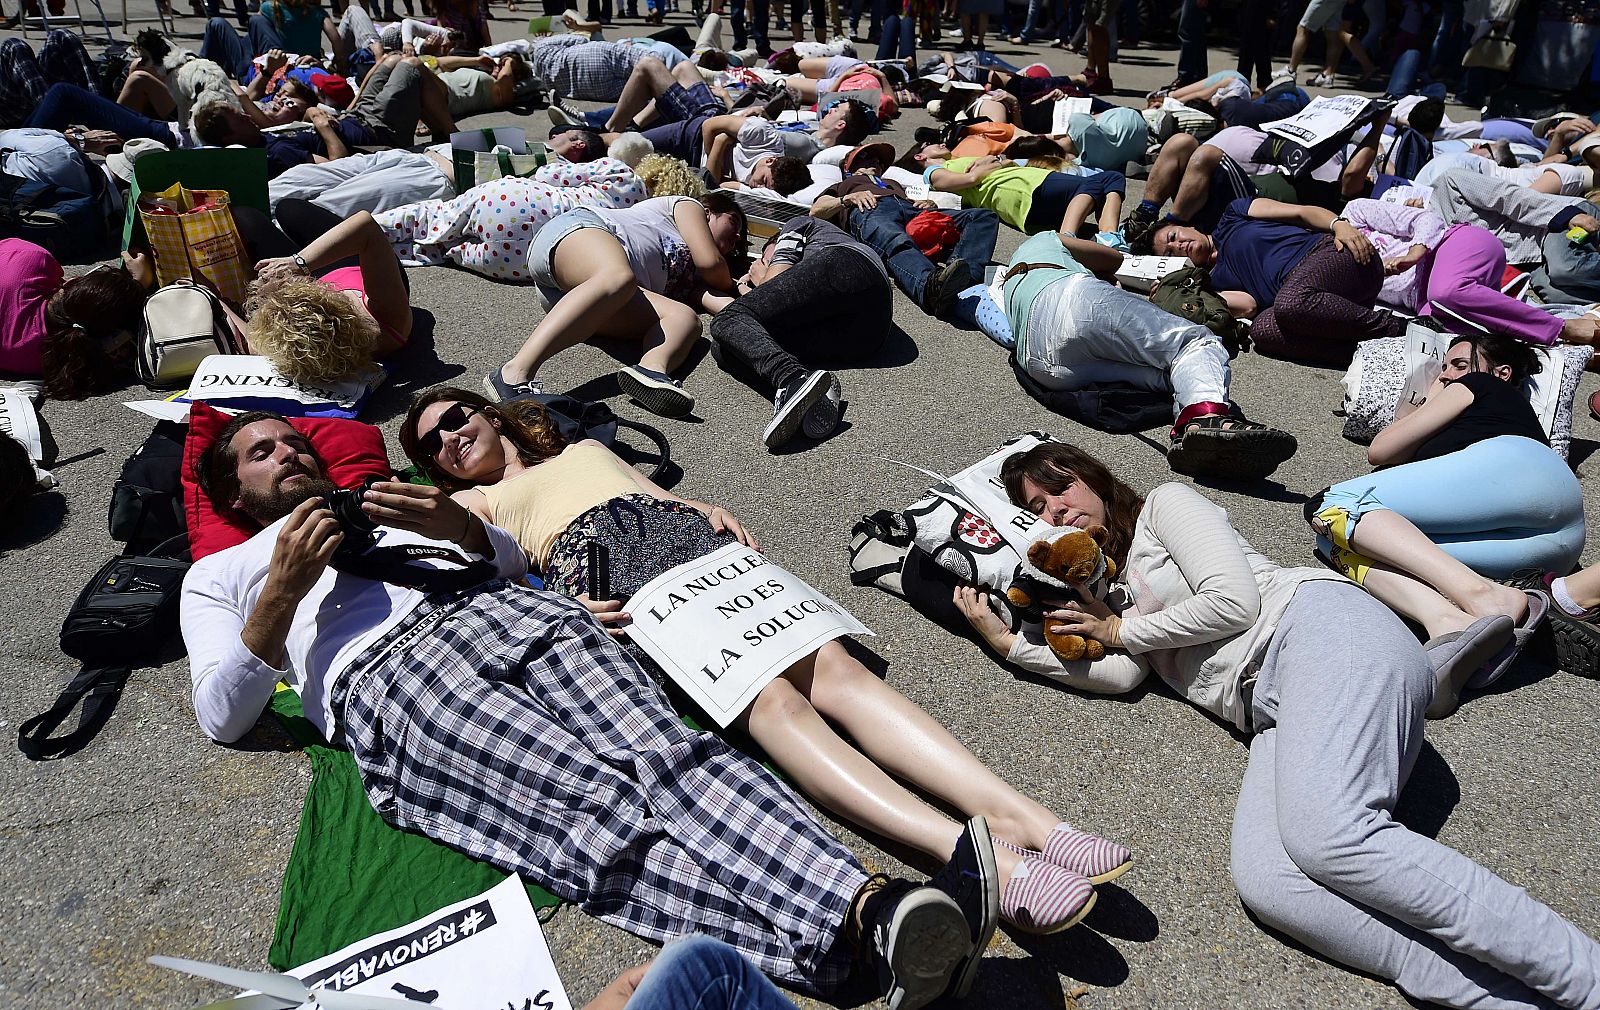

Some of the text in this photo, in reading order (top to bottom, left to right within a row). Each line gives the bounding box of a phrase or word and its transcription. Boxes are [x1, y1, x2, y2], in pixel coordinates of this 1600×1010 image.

[1420, 342, 1440, 361] LA
[406, 548, 450, 556] Canon
[648, 591, 690, 625] LA
[715, 579, 786, 620] NO ES
[700, 647, 744, 685] LA
